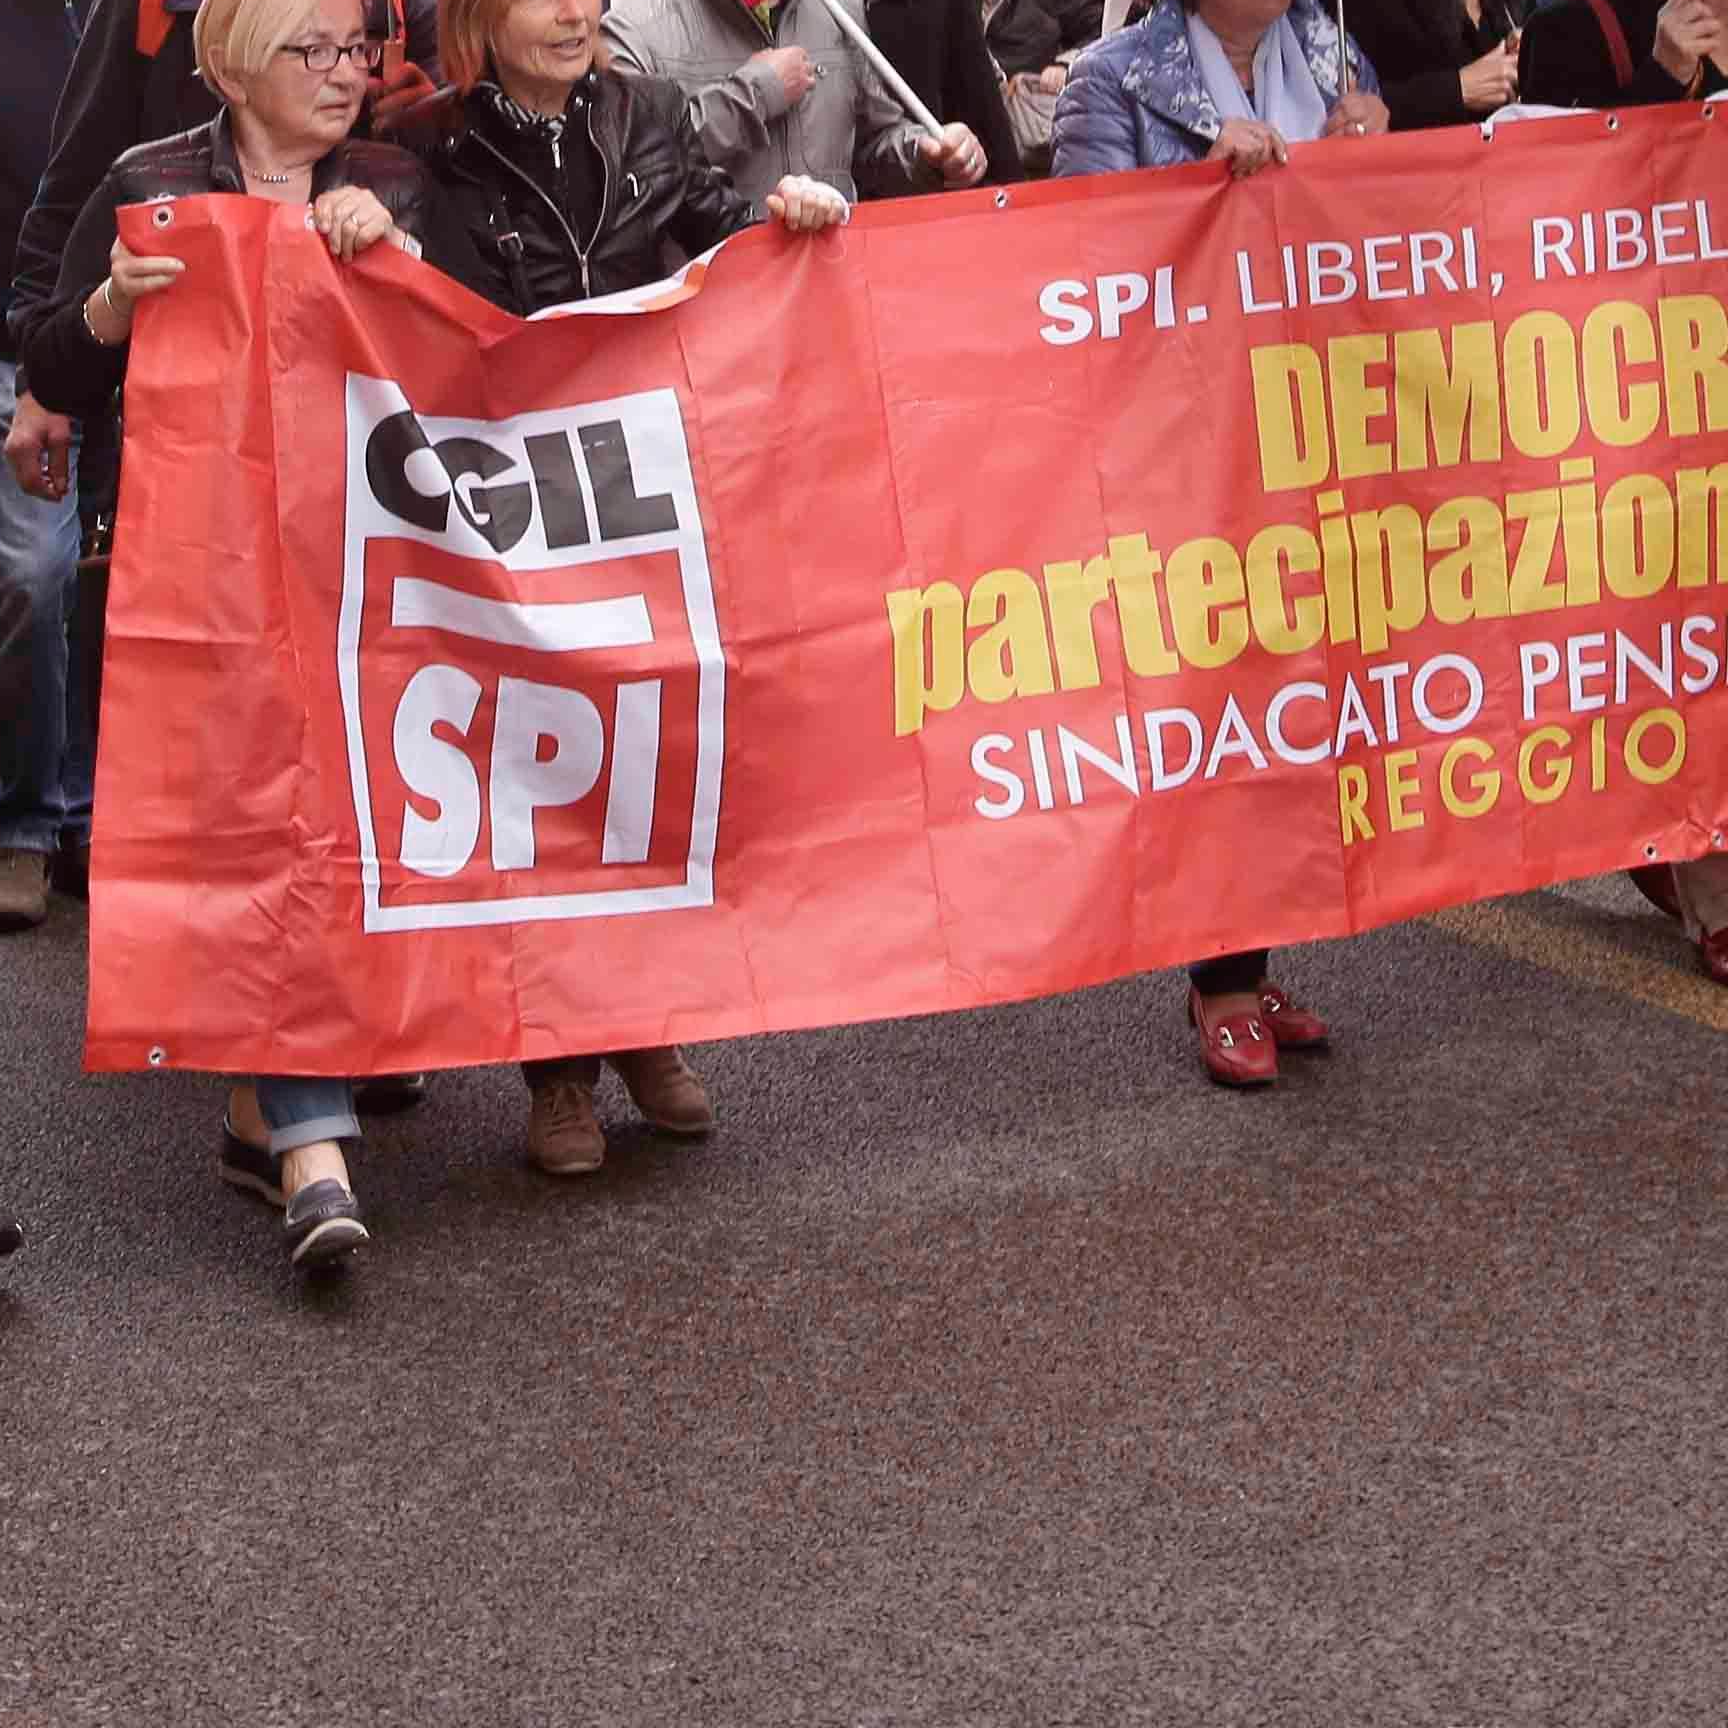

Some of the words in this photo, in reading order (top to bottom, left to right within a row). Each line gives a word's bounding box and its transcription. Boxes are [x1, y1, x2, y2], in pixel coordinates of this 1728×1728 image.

[1038, 266, 1207, 345] SPI.
[1237, 227, 1504, 314] LIBERI,
[365, 410, 679, 553] CGIL
[393, 663, 662, 879] SPI
[971, 653, 1483, 820] SINDACATO
[1338, 707, 1686, 846] REGGIO
